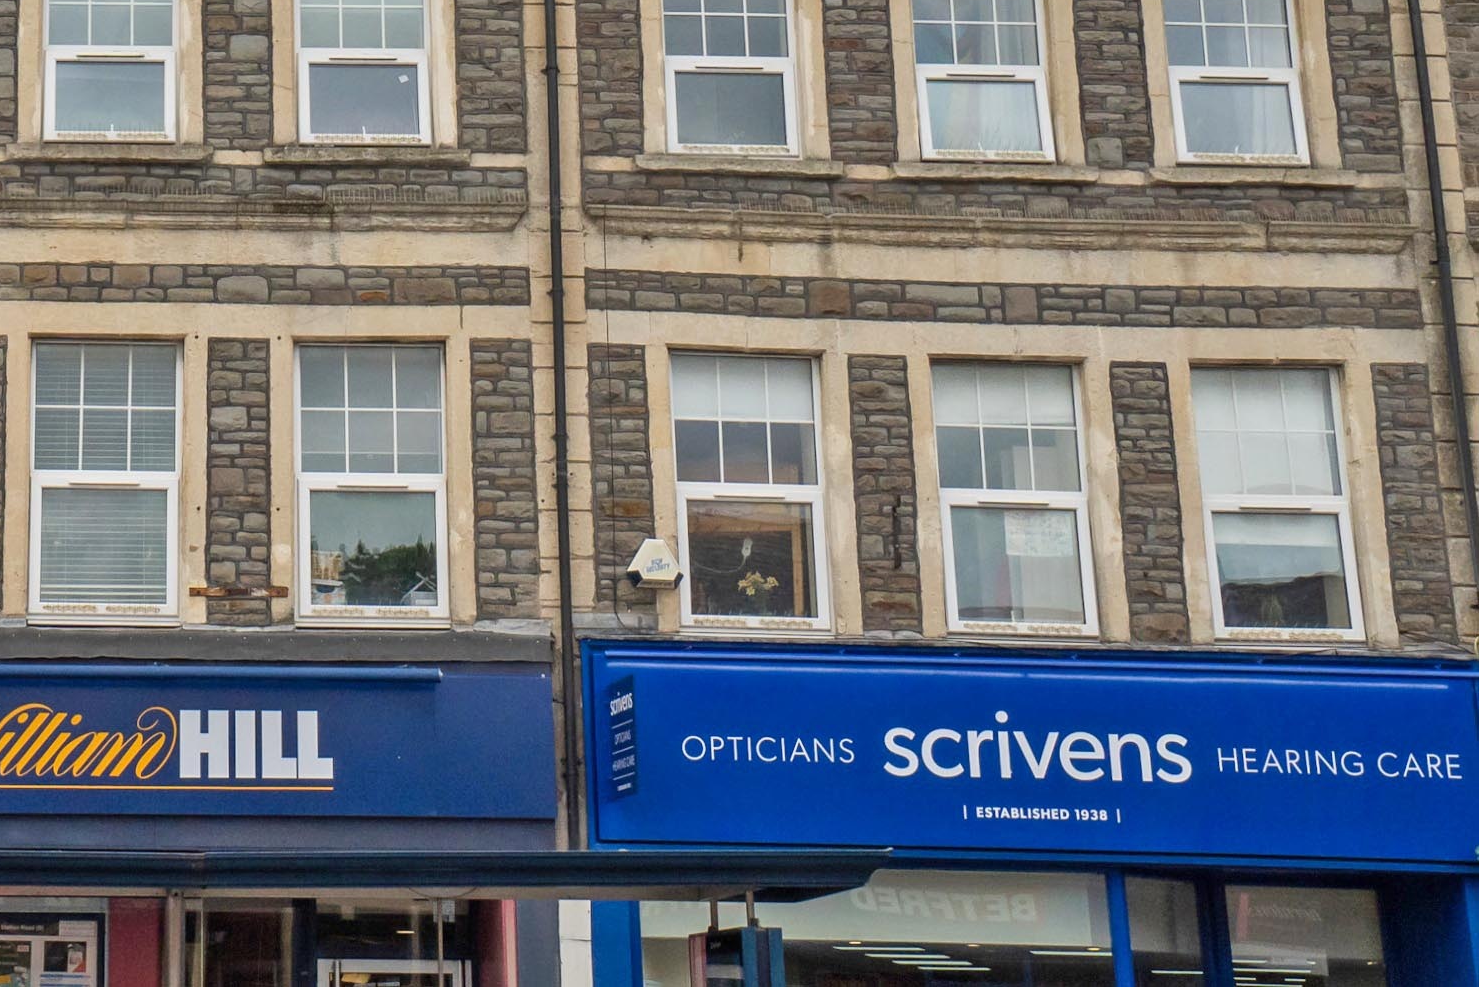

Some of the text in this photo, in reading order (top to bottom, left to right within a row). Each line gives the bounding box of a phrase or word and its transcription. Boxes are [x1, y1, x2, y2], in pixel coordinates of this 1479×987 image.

[179, 710, 334, 779] HILL
[681, 735, 856, 764] OPTICIANS
[883, 710, 1193, 784] scrivens
[1217, 747, 1463, 780] HEARING CARE
[975, 806, 1108, 822] ESTABLISHED 1938
